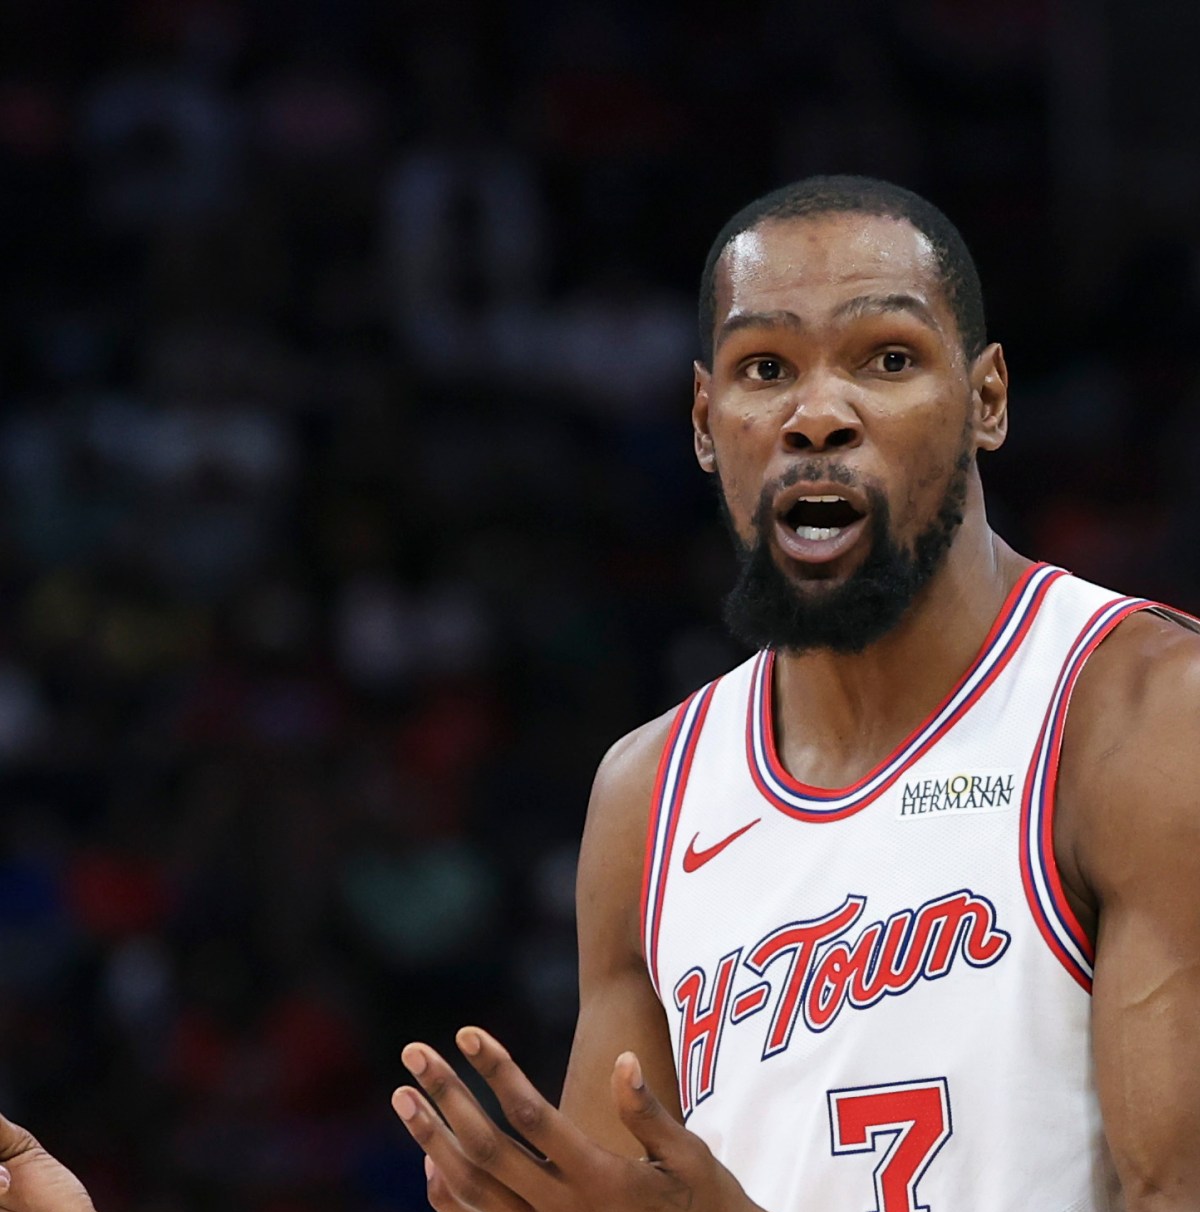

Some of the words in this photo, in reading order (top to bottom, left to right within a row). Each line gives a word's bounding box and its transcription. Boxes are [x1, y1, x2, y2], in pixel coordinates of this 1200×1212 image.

[902, 774, 1016, 800] MEMORIAL
[900, 789, 1013, 816] HERMANN
[673, 888, 1012, 1127] H-Town
